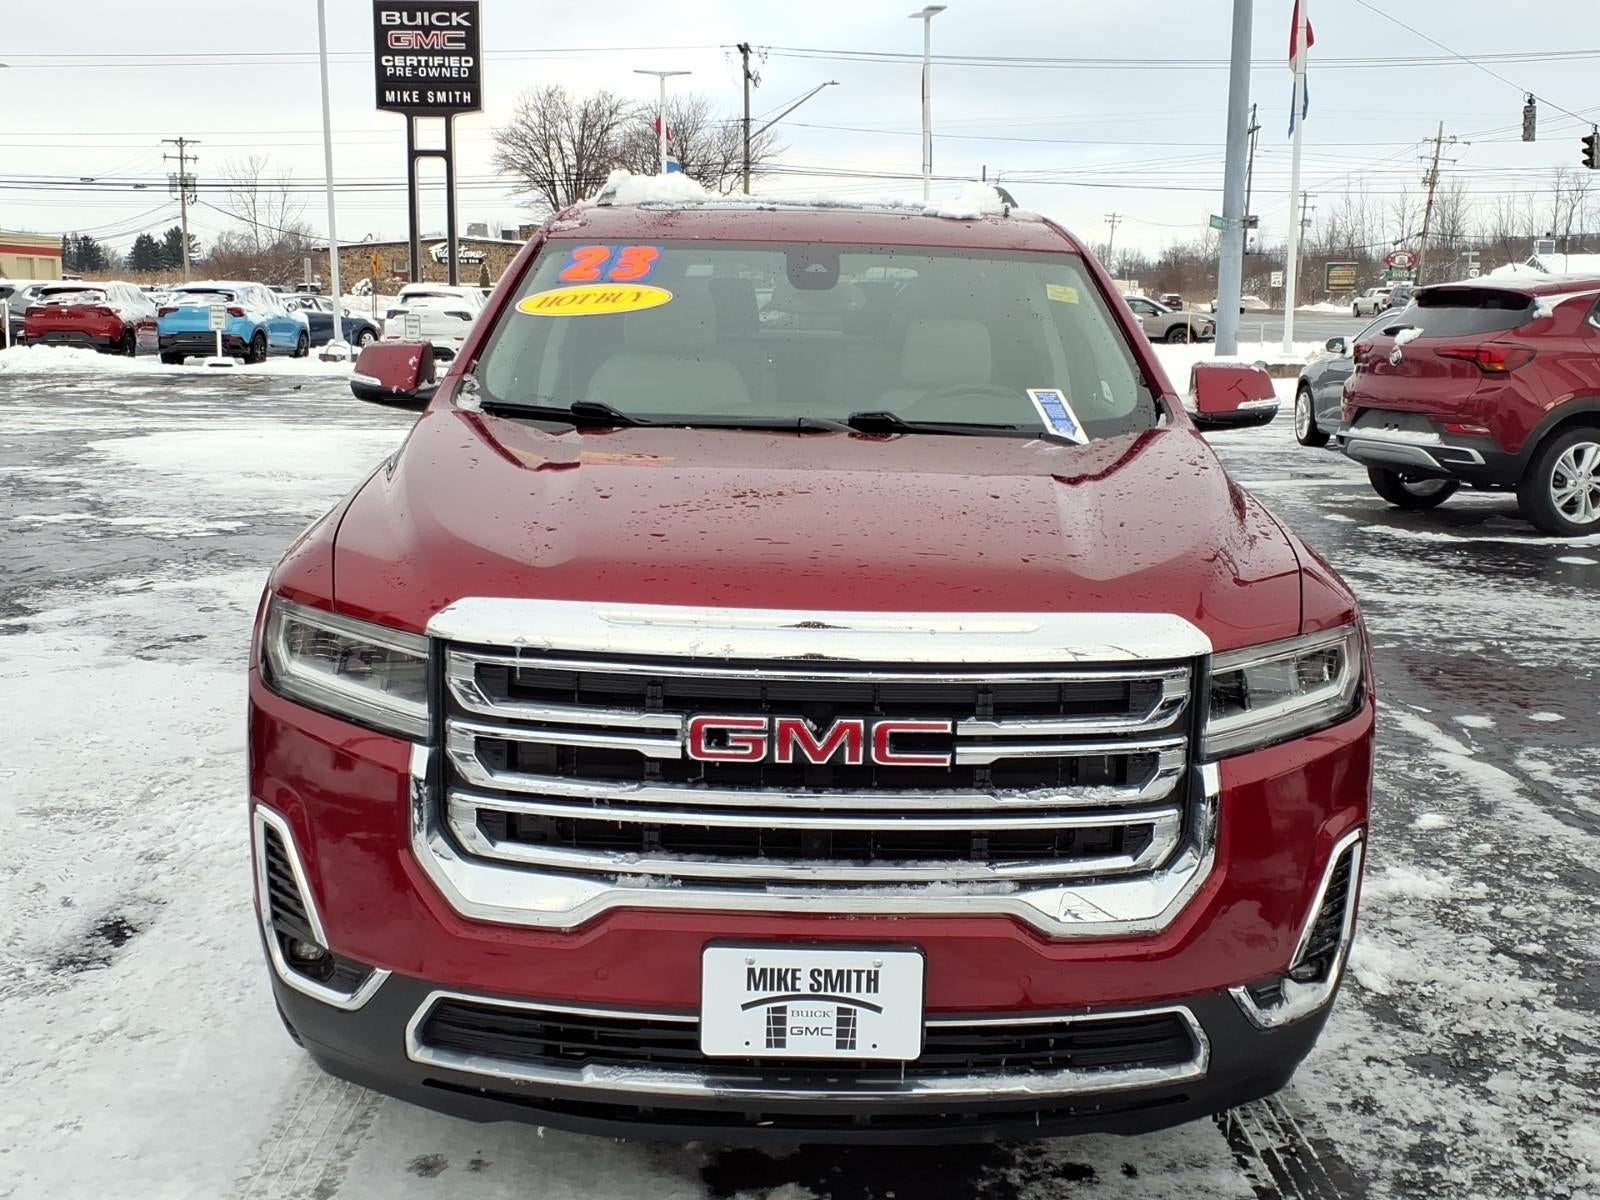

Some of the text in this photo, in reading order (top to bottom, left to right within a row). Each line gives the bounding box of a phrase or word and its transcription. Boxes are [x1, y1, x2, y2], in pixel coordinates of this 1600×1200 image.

[381, 11, 472, 26] BUICK
[387, 30, 466, 50] GMC
[381, 55, 474, 67] CERTIFIED
[386, 67, 469, 77] PRE-OWNED
[385, 90, 471, 103] MIKE SMITH
[559, 245, 660, 281] 23
[536, 290, 651, 309] HOT BUY
[686, 715, 952, 766] GMC
[746, 967, 880, 994] MIKE SMITH
[790, 1009, 831, 1018] BUICK
[789, 1026, 833, 1037] GMC
